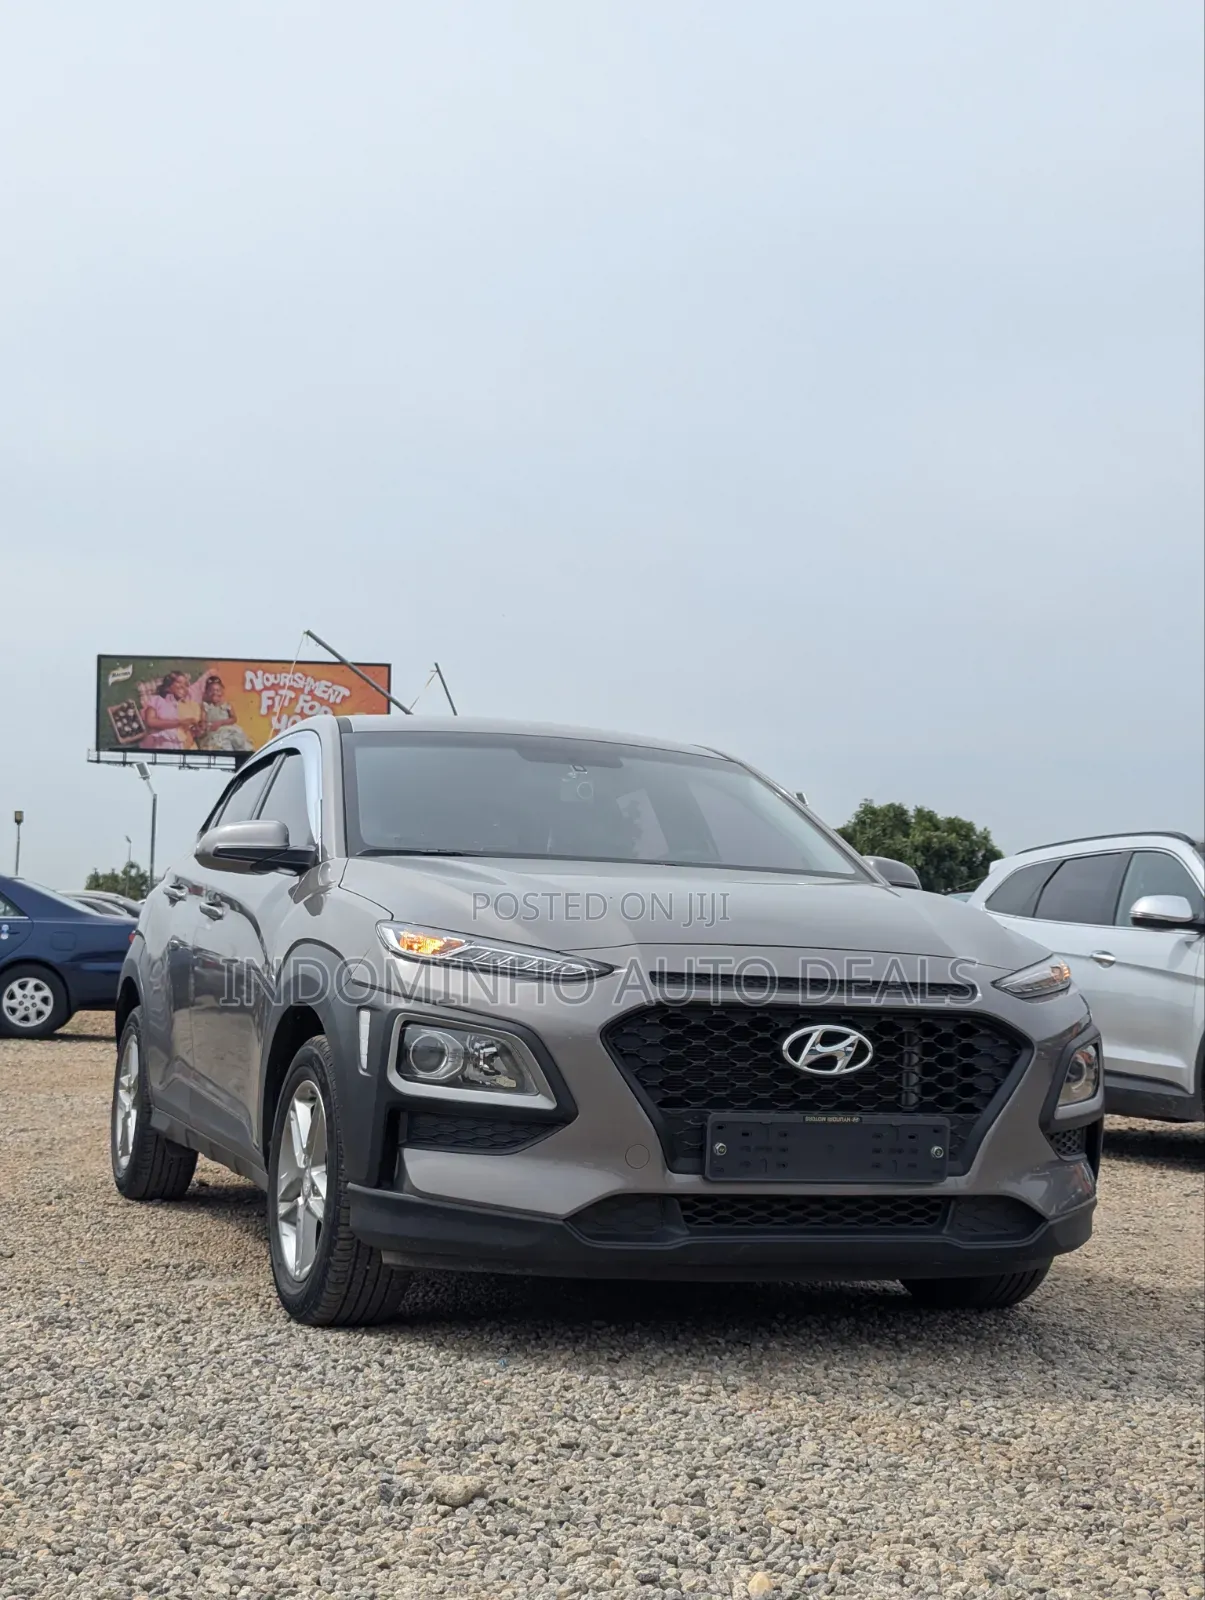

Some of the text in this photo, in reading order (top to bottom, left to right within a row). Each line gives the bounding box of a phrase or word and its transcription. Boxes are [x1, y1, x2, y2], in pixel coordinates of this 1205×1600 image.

[244, 670, 351, 703] NOURISHMENT
[260, 689, 333, 716] FIT FOR
